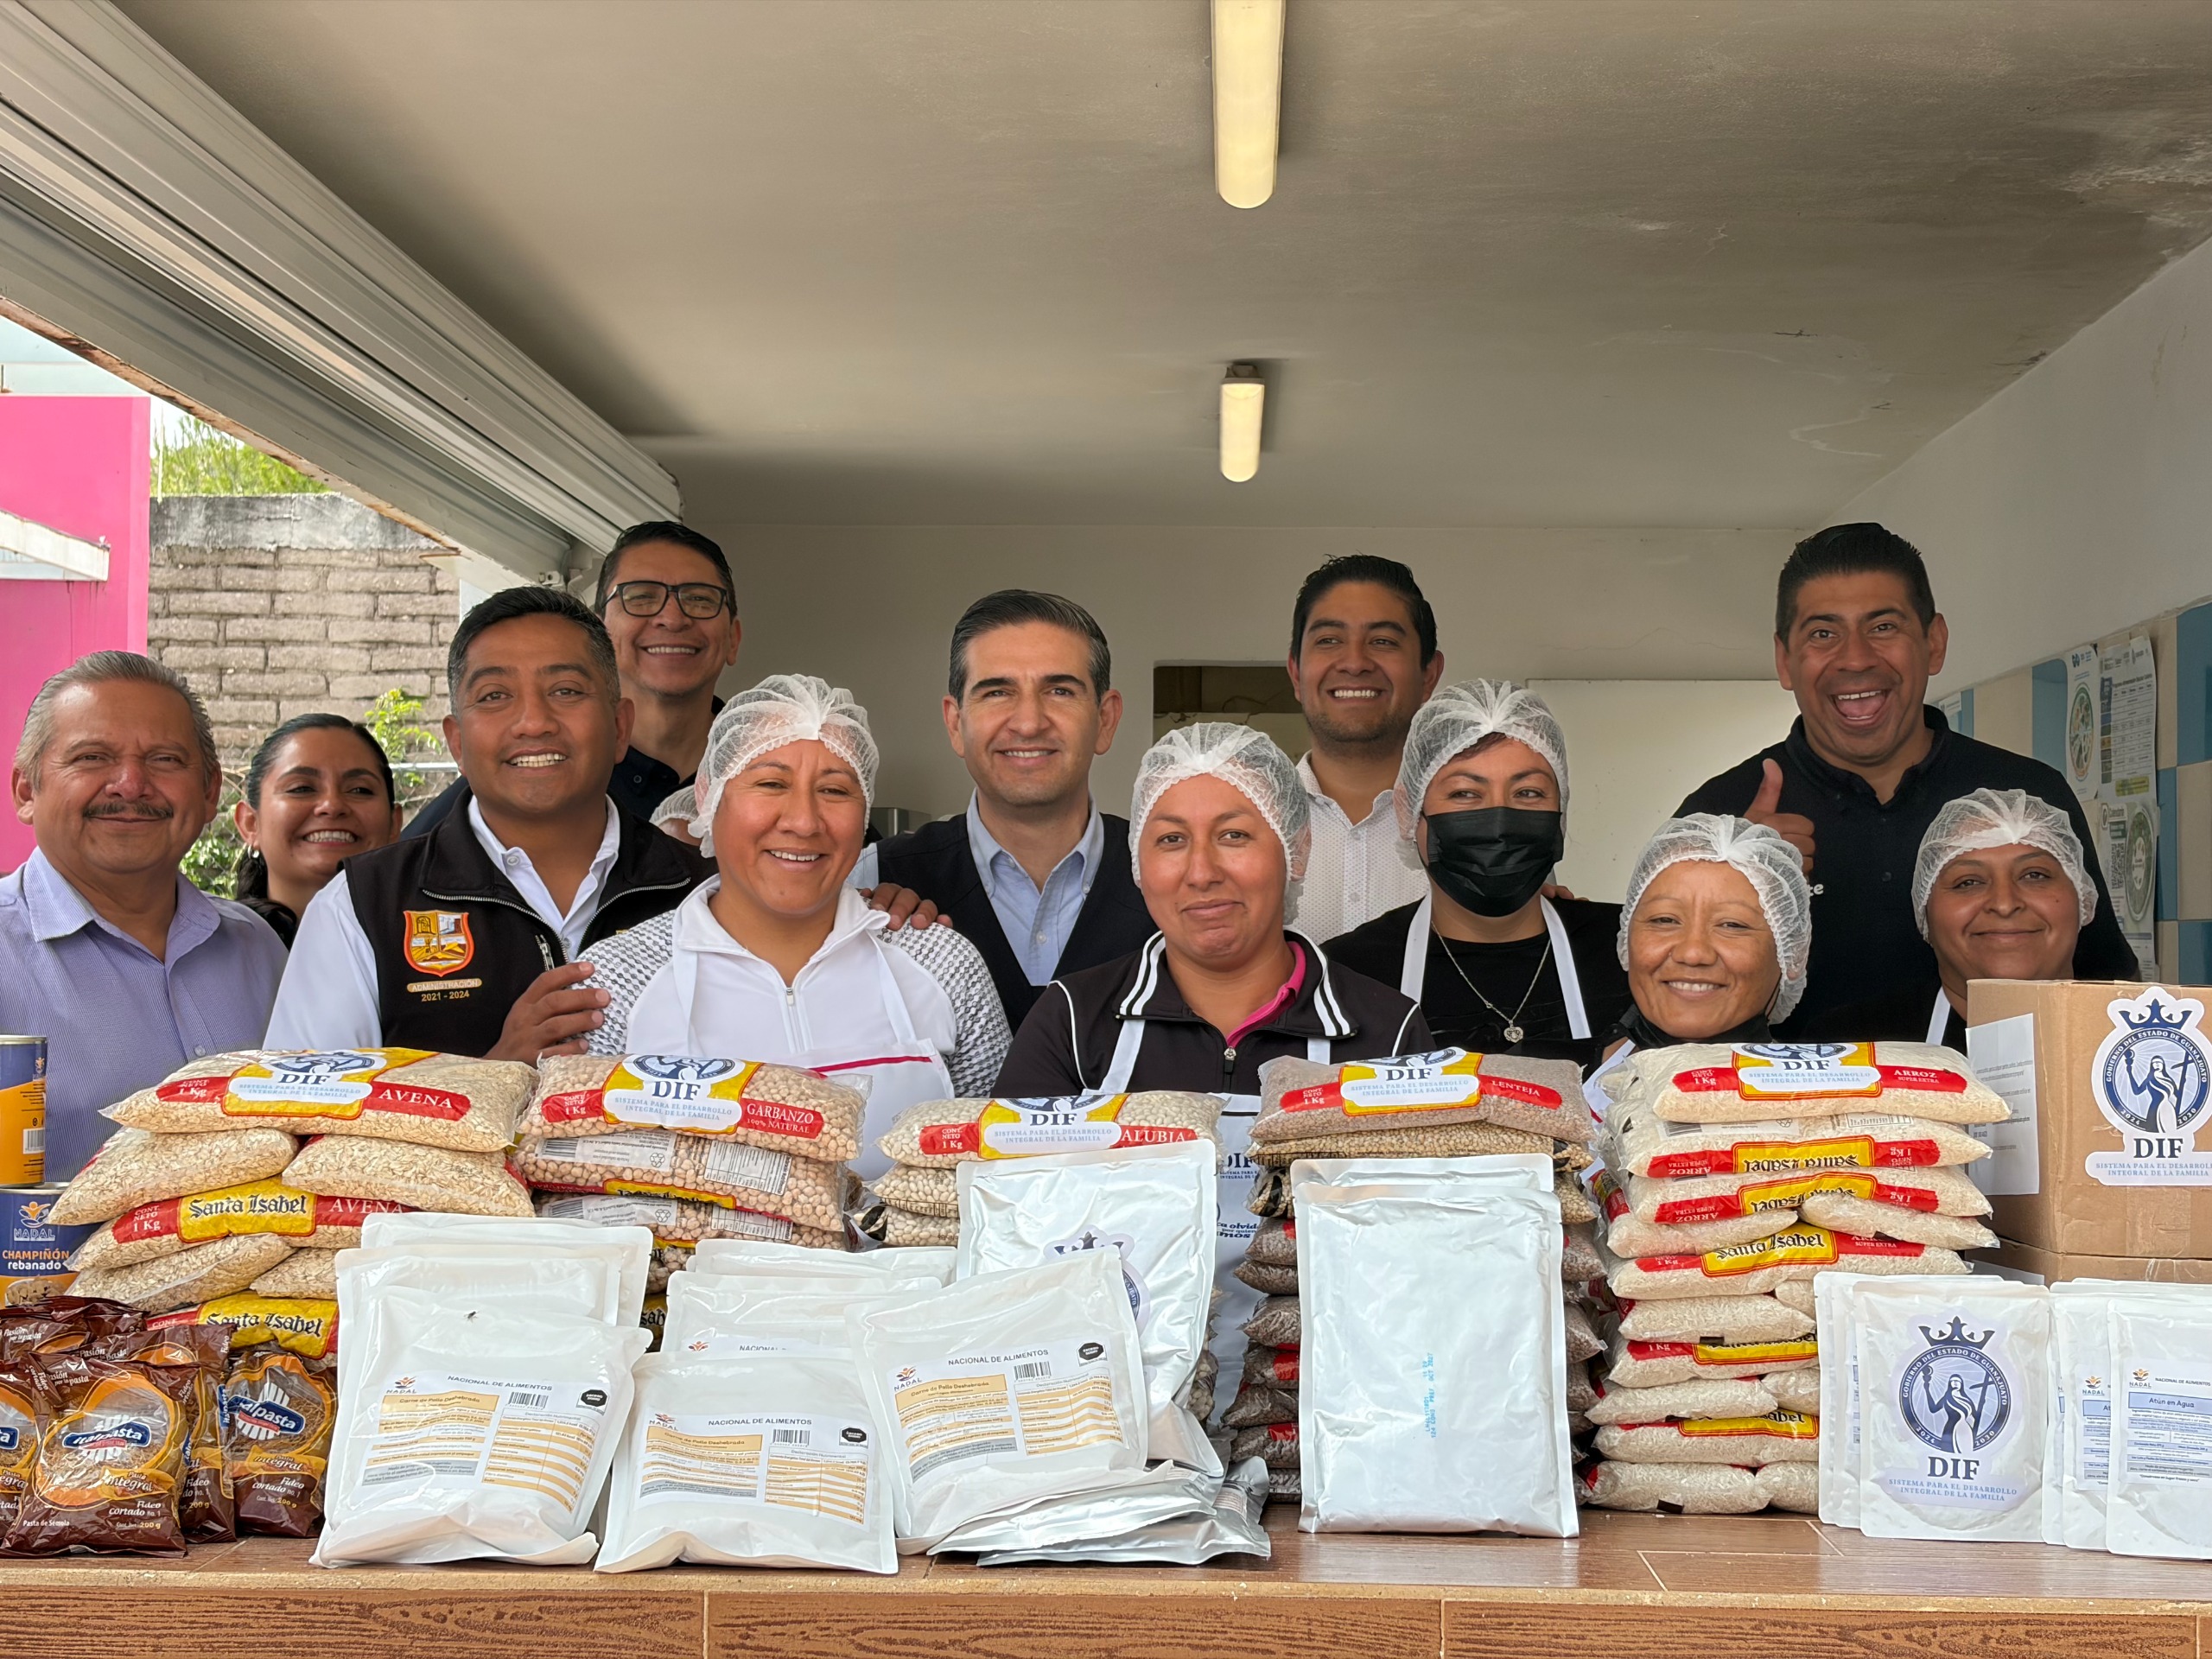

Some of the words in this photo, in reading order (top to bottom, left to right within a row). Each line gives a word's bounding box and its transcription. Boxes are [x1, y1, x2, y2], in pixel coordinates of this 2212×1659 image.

[422, 992, 442, 1002] 2021
[449, 990, 470, 1000] 2024
[2107, 1046, 2124, 1083] GOBIERNO
[2124, 1036, 2138, 1047] DEL
[2138, 1030, 2168, 1039] ESTADO
[2170, 1033, 2181, 1041] DE
[2180, 1039, 2208, 1084] GUANAJUATO
[1782, 1059, 1830, 1071] DIF
[278, 1073, 330, 1085] DIF
[1386, 1068, 1433, 1081] DIF
[1894, 1069, 1937, 1078] ARROZ
[1701, 1077, 1717, 1086] Kg
[190, 1087, 207, 1098] Kg
[652, 1080, 702, 1101] DIF
[1491, 1080, 1541, 1097] LENTEJA
[378, 1089, 453, 1109] AVENA
[1311, 1096, 1325, 1106] Kg
[573, 1106, 587, 1116] Kg
[614, 1096, 648, 1106] SISTEMA
[650, 1100, 670, 1109] PARA
[682, 1103, 733, 1116] DESARROLLO
[625, 1105, 664, 1116] INTEGRAL
[688, 1110, 721, 1121] FAMILIA
[747, 1103, 815, 1124] GARBANZO
[2120, 1109, 2140, 1126] 2024
[2178, 1108, 2196, 1125] 2030
[1030, 1113, 1077, 1126] DIF
[747, 1118, 766, 1127] 100%
[767, 1119, 810, 1135] NATURAL
[1121, 1128, 1187, 1143] ALUBIA
[942, 1140, 946, 1148] 1
[949, 1140, 963, 1150] Kg
[2133, 1138, 2184, 1159] DIF
[1890, 1147, 1904, 1157] Kg
[1668, 1166, 1712, 1175] ARROZ
[1890, 1191, 1904, 1203] Kg
[189, 1197, 244, 1219] Santa
[248, 1193, 308, 1215] Isabel
[328, 1198, 404, 1214] AVENA
[133, 1211, 158, 1222] NETO
[1675, 1212, 1719, 1223] ARROZ
[133, 1223, 138, 1232] 1
[143, 1220, 162, 1232] Kg
[14, 1228, 55, 1239] NADAL
[1716, 1243, 1765, 1260] Santa
[1768, 1232, 1825, 1253] Isabel
[3, 1247, 70, 1260] CHAMPIÑÓN
[8, 1260, 62, 1271] rebanado
[1664, 1258, 1679, 1267] Kg
[264, 1312, 323, 1338] Isabel
[79, 1346, 105, 1357] Pasión
[1656, 1343, 1670, 1351] Kg
[948, 1356, 989, 1366] NACIONAL
[990, 1355, 1002, 1363] DE
[1003, 1349, 1049, 1363] ALIMENTOS
[69, 1375, 91, 1387] pasta
[1903, 1362, 1922, 1398] GOBIERNO
[1922, 1352, 1936, 1363] DEL
[1937, 1348, 1969, 1357] ESTADO
[1970, 1351, 1980, 1360] DE
[1980, 1358, 2007, 1405] GUANAJUATO
[447, 1375, 490, 1386] NACIONAL
[505, 1382, 553, 1391] ALIMENTOS
[893, 1376, 923, 1392] NADAL
[911, 1388, 930, 1397] Carne
[2149, 1397, 2166, 1406] Atún
[238, 1402, 296, 1430] alpasta
[708, 1418, 751, 1427] NACIONAL
[765, 1417, 812, 1426] ALIMENTOS
[649, 1419, 678, 1432] NADAL
[73, 1427, 143, 1445] italpasta
[1916, 1426, 1936, 1444] 2024
[1975, 1430, 1995, 1446] 2030
[254, 1455, 304, 1471] integral
[1928, 1456, 1980, 1480] DIF
[186, 1478, 210, 1487] Fideo
[252, 1481, 286, 1492] cortado
[281, 1477, 305, 1489] Fideo
[1889, 1478, 1924, 1487] SISTEMA
[1963, 1484, 2018, 1495] DESARROLLO
[1901, 1486, 1942, 1496] INTEGRAL
[137, 1500, 162, 1509] Fideo
[109, 1508, 145, 1516] cortado
